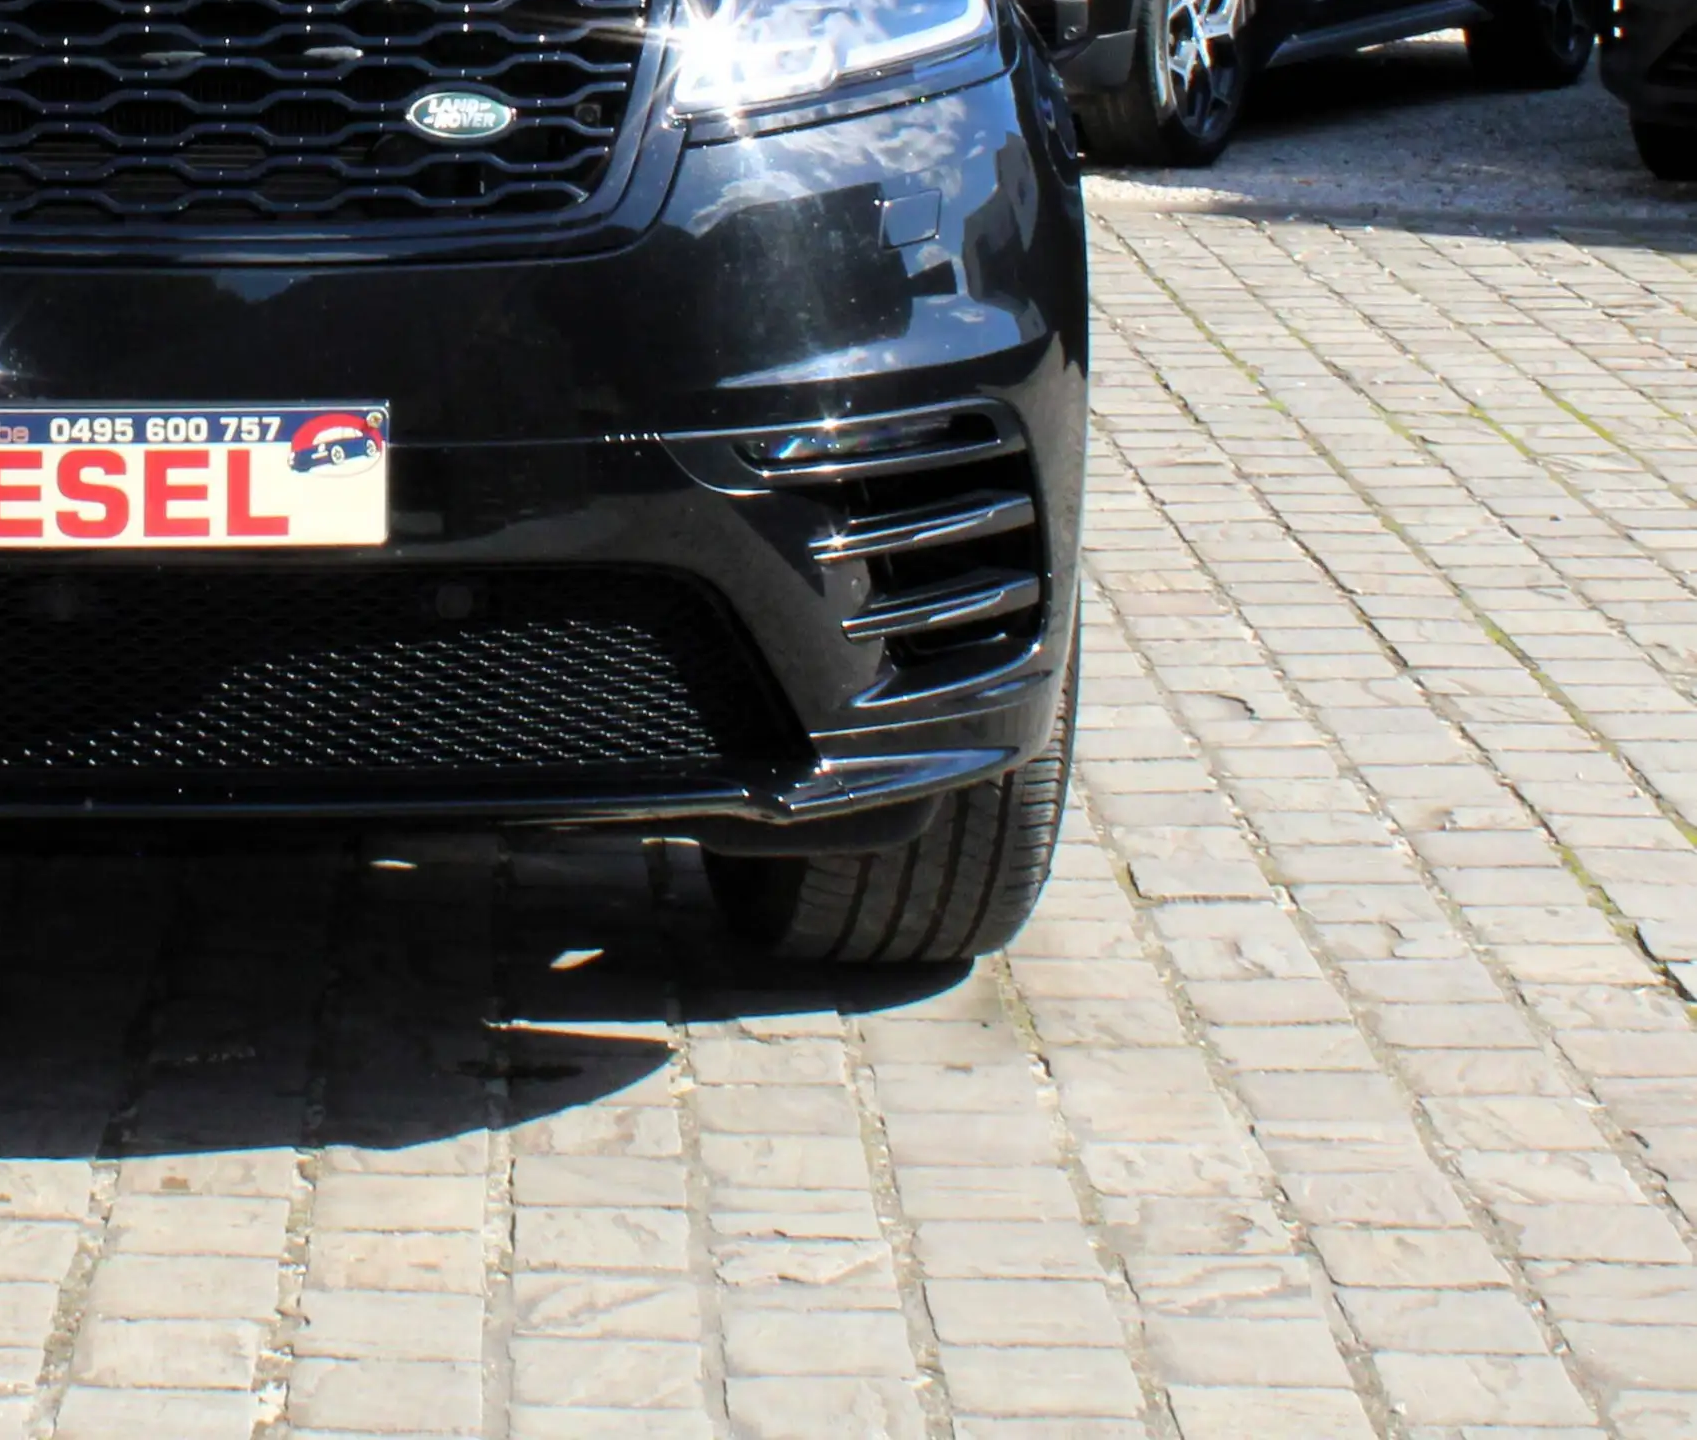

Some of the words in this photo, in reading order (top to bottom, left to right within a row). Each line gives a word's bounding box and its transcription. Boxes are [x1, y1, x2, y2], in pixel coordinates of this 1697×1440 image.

[434, 112, 497, 128] ROVER
[49, 416, 134, 443] 0495
[146, 416, 209, 443] 600
[219, 415, 282, 443] 757
